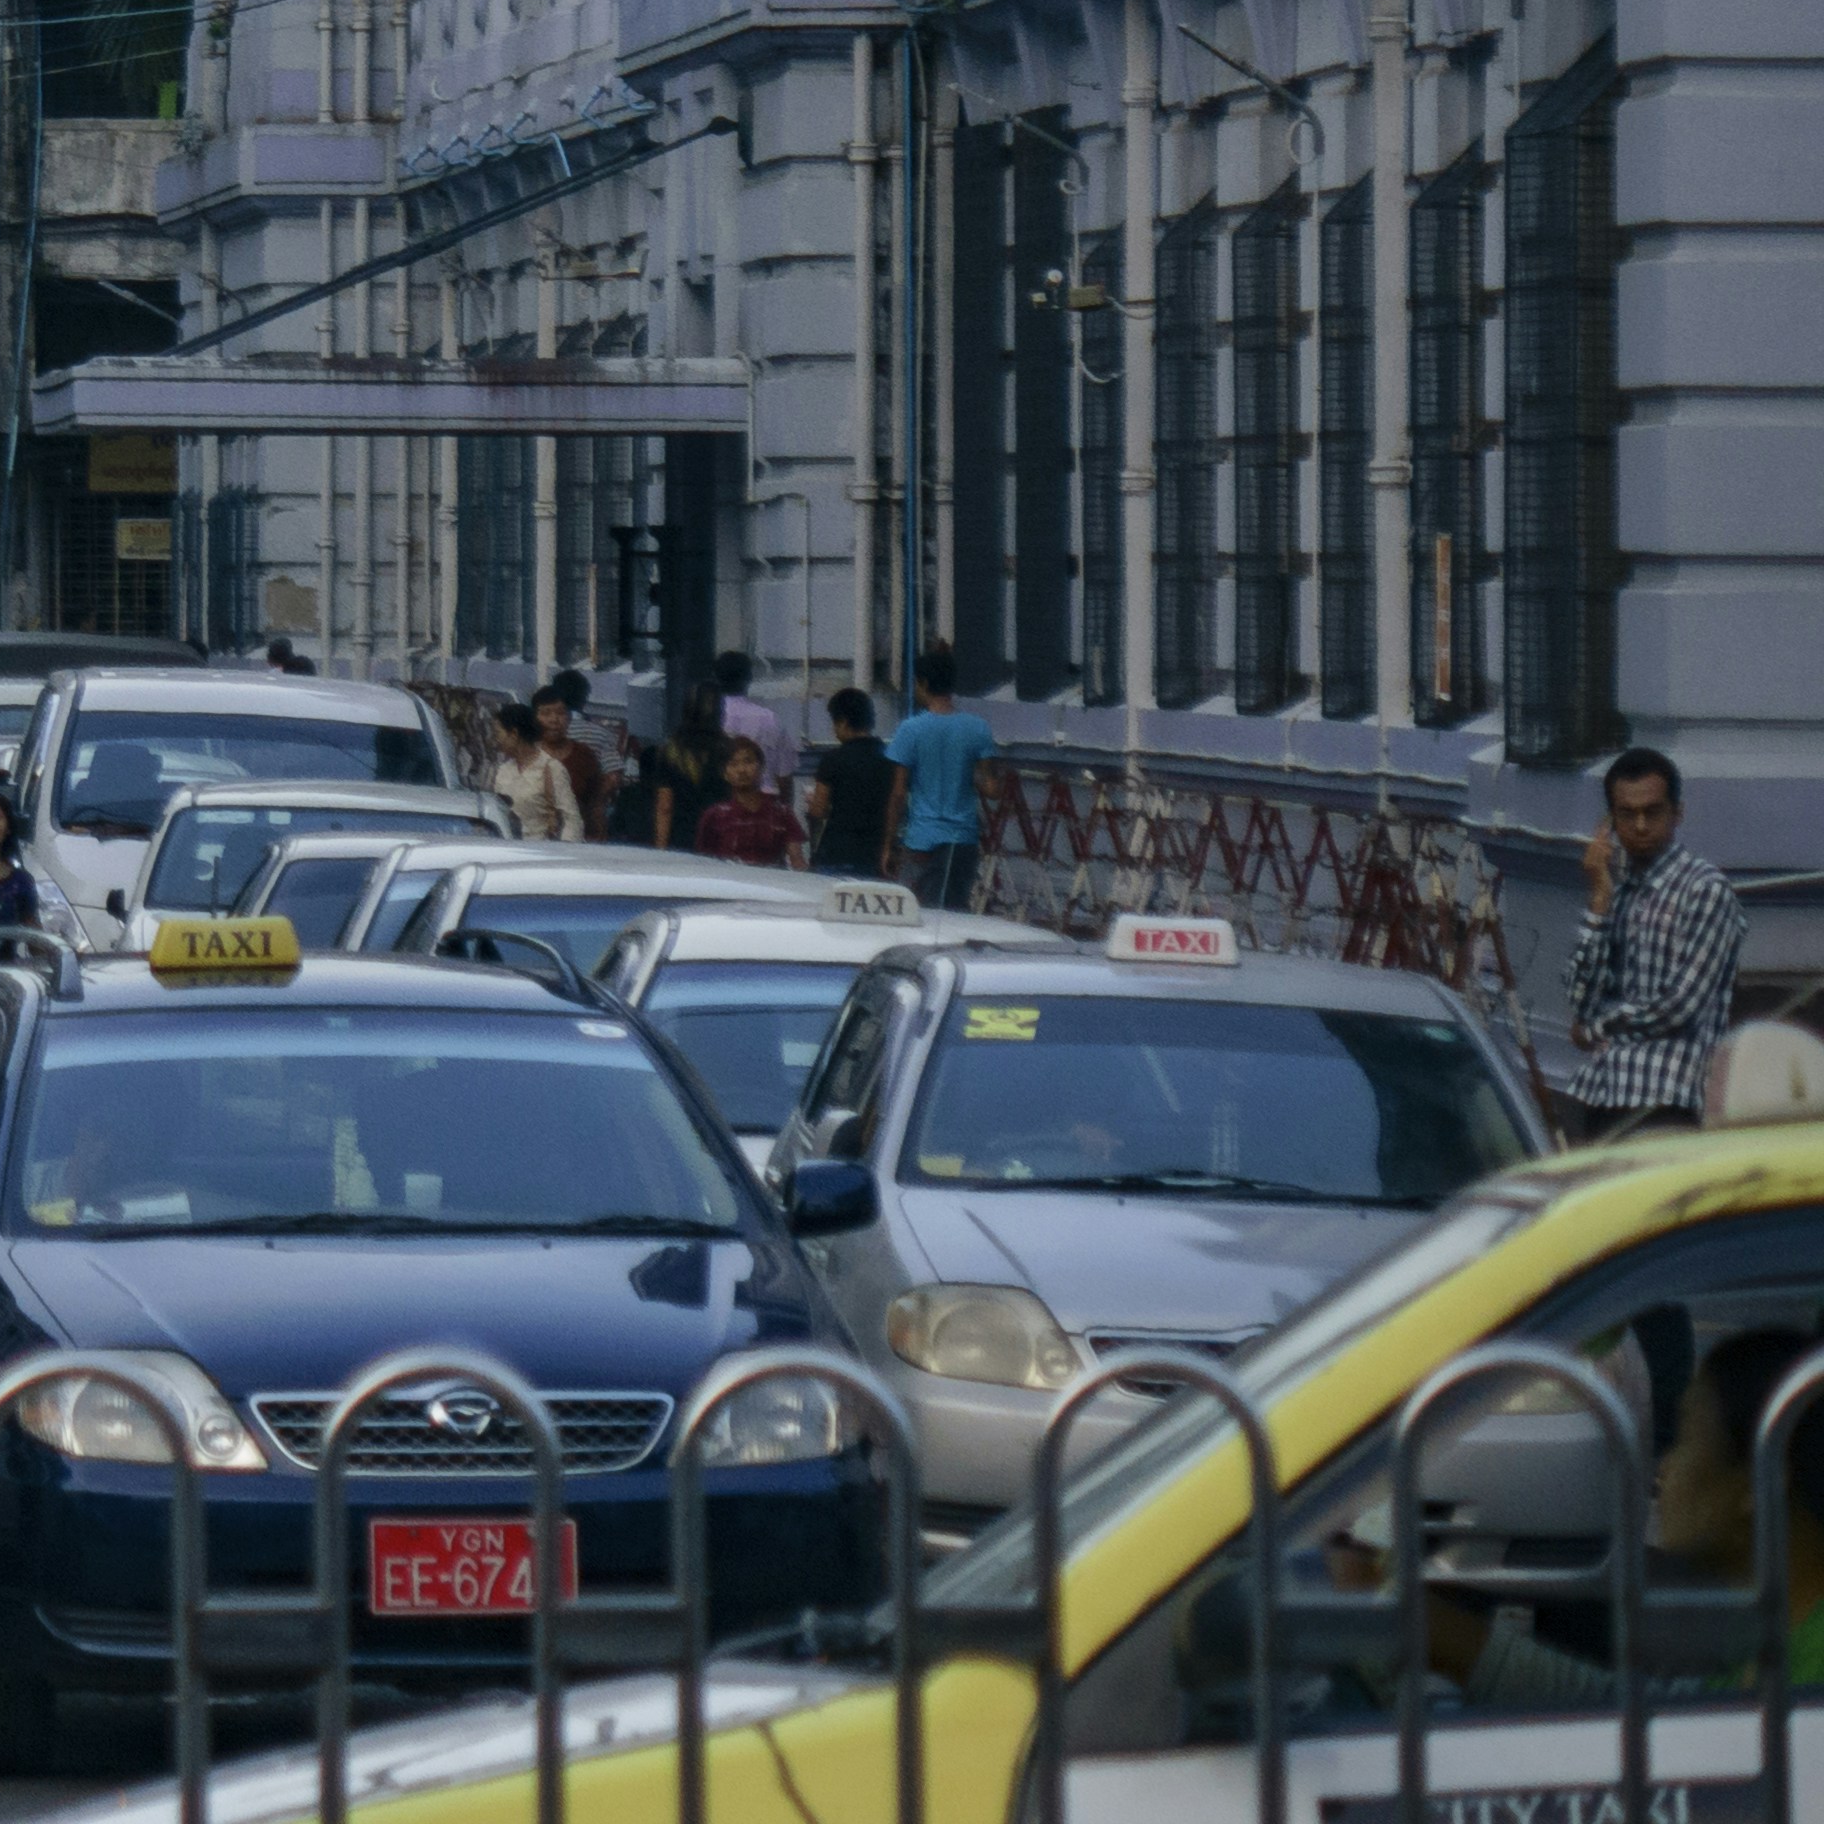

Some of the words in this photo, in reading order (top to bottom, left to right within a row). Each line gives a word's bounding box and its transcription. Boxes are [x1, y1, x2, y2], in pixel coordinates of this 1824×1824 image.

[834, 891, 905, 916] TAXI
[181, 930, 273, 959] TAXI
[1139, 929, 1217, 955] TAXI
[439, 1527, 505, 1553] YGN
